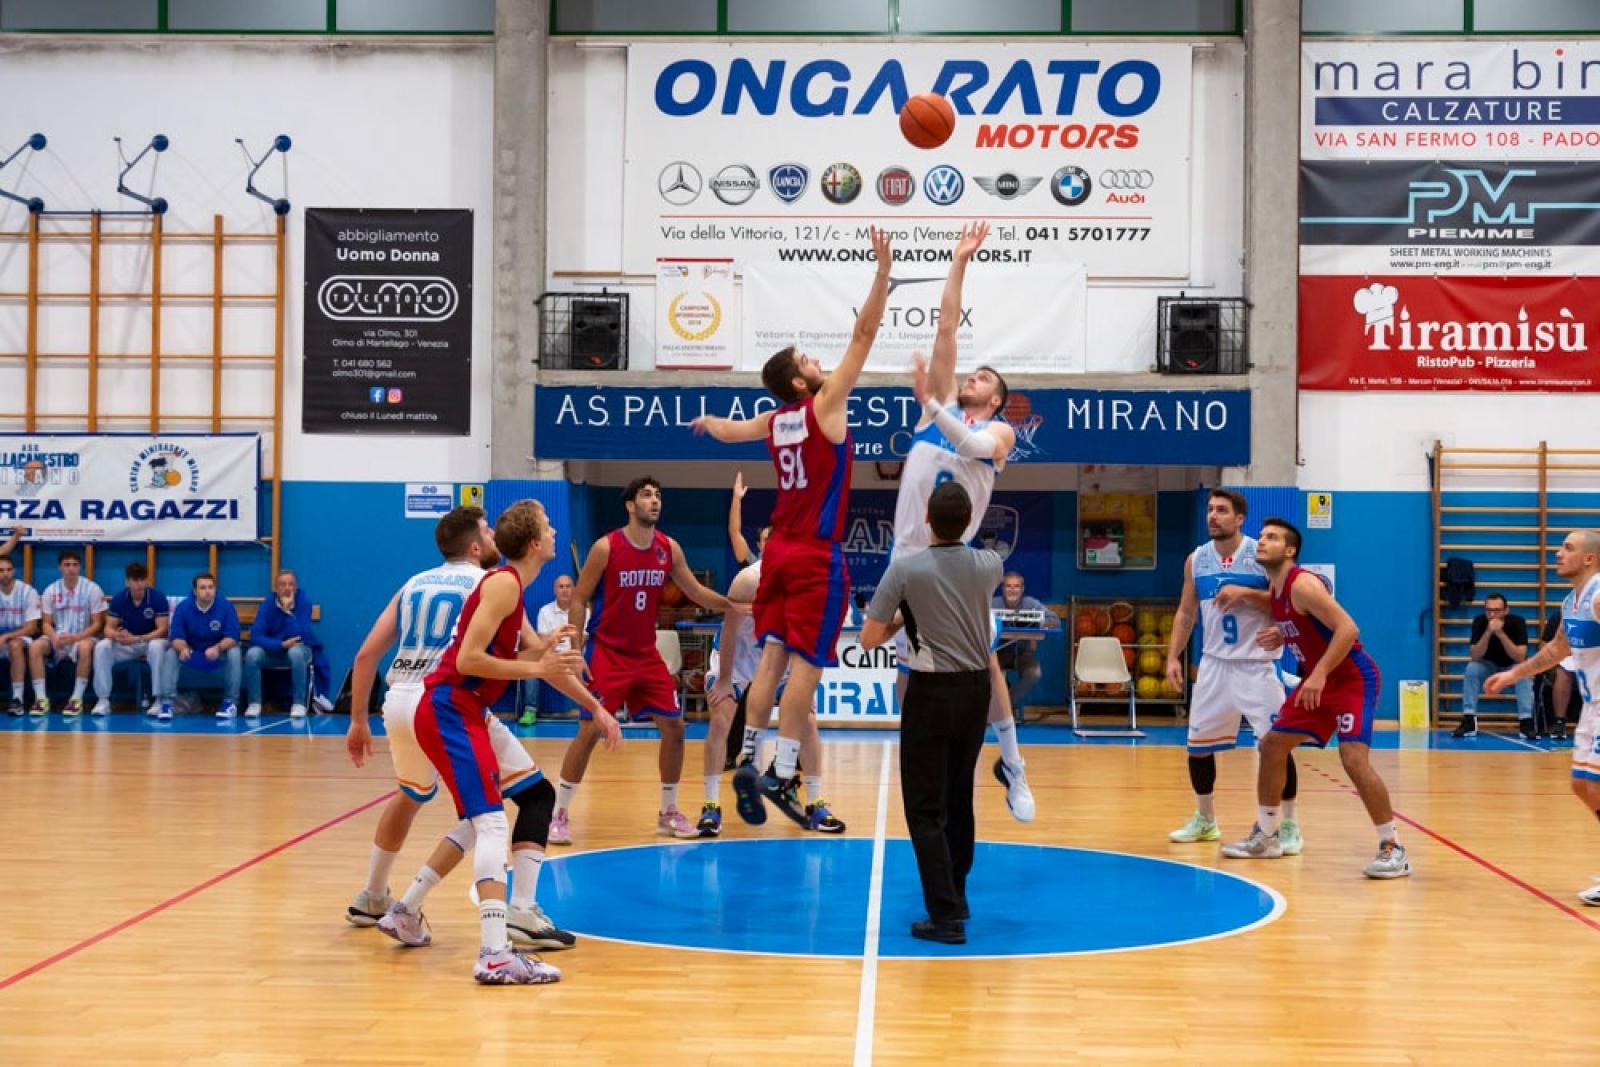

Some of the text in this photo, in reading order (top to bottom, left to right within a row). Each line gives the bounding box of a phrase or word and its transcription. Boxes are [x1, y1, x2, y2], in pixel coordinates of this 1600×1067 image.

[1314, 61, 1471, 91] mara
[654, 57, 1161, 117] ONGARATO
[1381, 101, 1563, 121] CALZATURE
[975, 123, 1139, 150] MOTORS
[1314, 132, 1348, 146] VIA
[1356, 132, 1397, 146] SAN
[1405, 132, 1477, 146] FERMO
[1485, 132, 1520, 146] 108
[712, 179, 757, 188] NISSAN
[885, 178, 908, 196] FIAT
[1105, 192, 1145, 204] Audi
[337, 229, 439, 243] abbigliamento
[660, 226, 686, 241] Via
[690, 224, 726, 241] della
[730, 225, 787, 243] Vittoria,
[795, 225, 840, 242] 121/c
[996, 227, 1020, 241] Tel.
[1026, 227, 1059, 242] 041
[1068, 227, 1151, 242] 5701777
[1407, 228, 1535, 240] PIEMME
[337, 248, 440, 262] Uomo Donna
[1389, 247, 1552, 258] SHEET METAL WORKING MACHINES
[1390, 259, 1460, 270] www.pm-eng.it
[404, 329, 418, 338] 301
[1364, 304, 1588, 353] Tiramisù
[332, 339, 355, 347] Olmo
[341, 359, 356, 367] 041
[1416, 356, 1475, 368] RistoPub
[1485, 357, 1537, 369] Pizzeria
[340, 411, 369, 420] chiuso
[1067, 397, 1228, 431] MIRANO
[778, 446, 809, 490] 91
[80, 498, 239, 520] RAGAZZI
[619, 570, 665, 588] ROVIGO
[634, 591, 647, 611] 8
[402, 590, 464, 648] 10
[1222, 615, 1238, 645] 9
